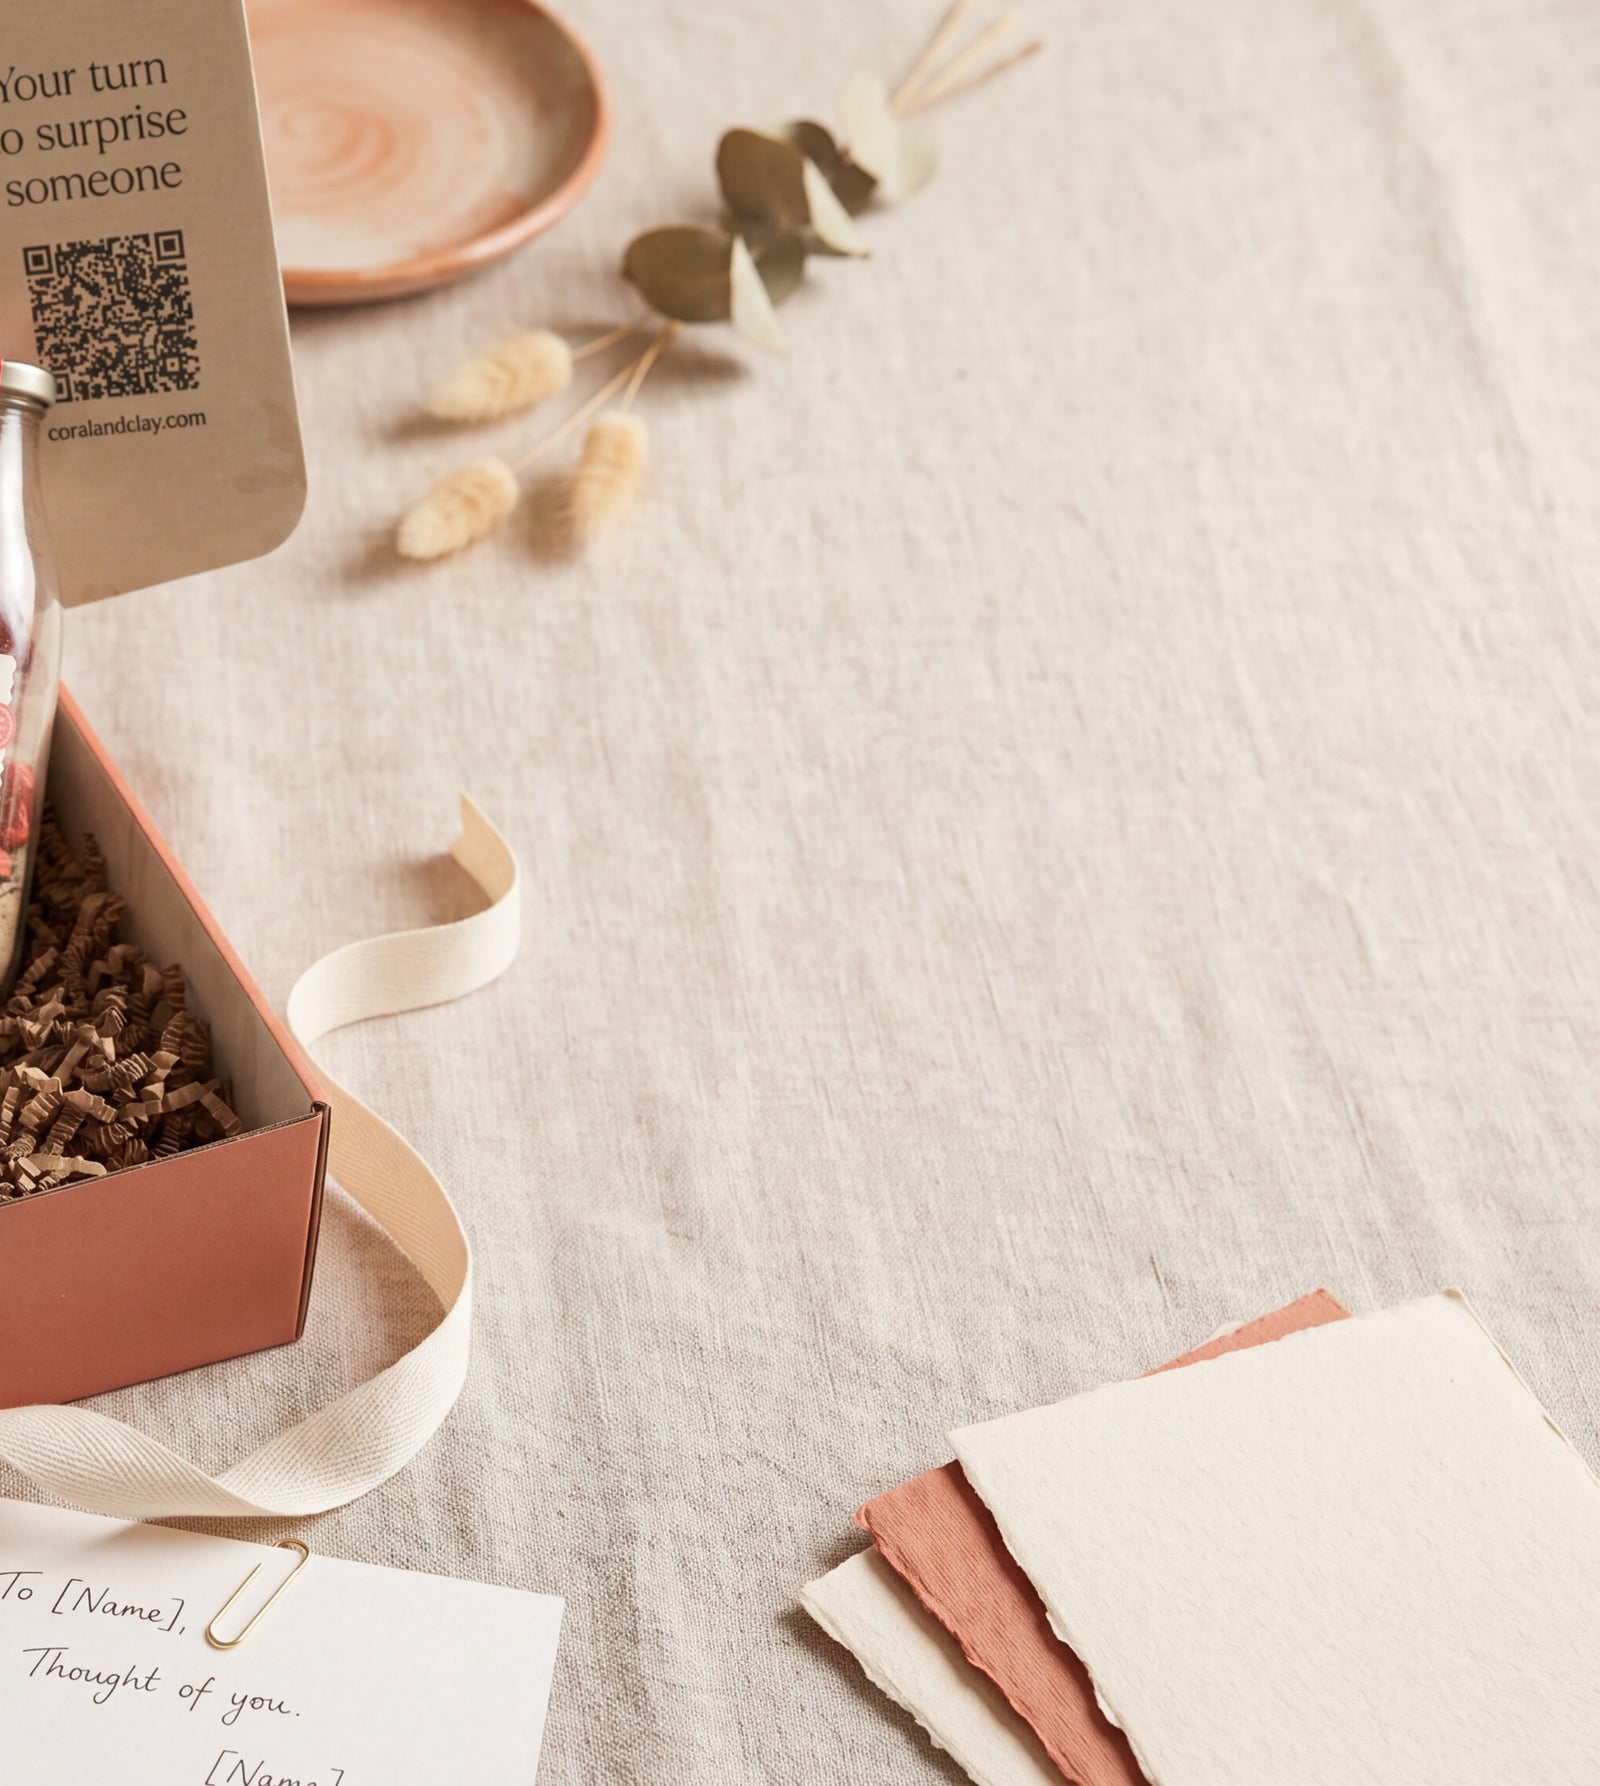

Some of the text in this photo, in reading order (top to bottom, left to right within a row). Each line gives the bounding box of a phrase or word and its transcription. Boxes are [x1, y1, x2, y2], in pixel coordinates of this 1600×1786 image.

[88, 57, 168, 92] turn
[36, 104, 189, 155] surprise
[5, 160, 184, 207] someone
[47, 411, 207, 441] coralandclay.com
[51, 1578, 186, 1635] [Name],
[21, 1646, 301, 1726] Thought of you.
